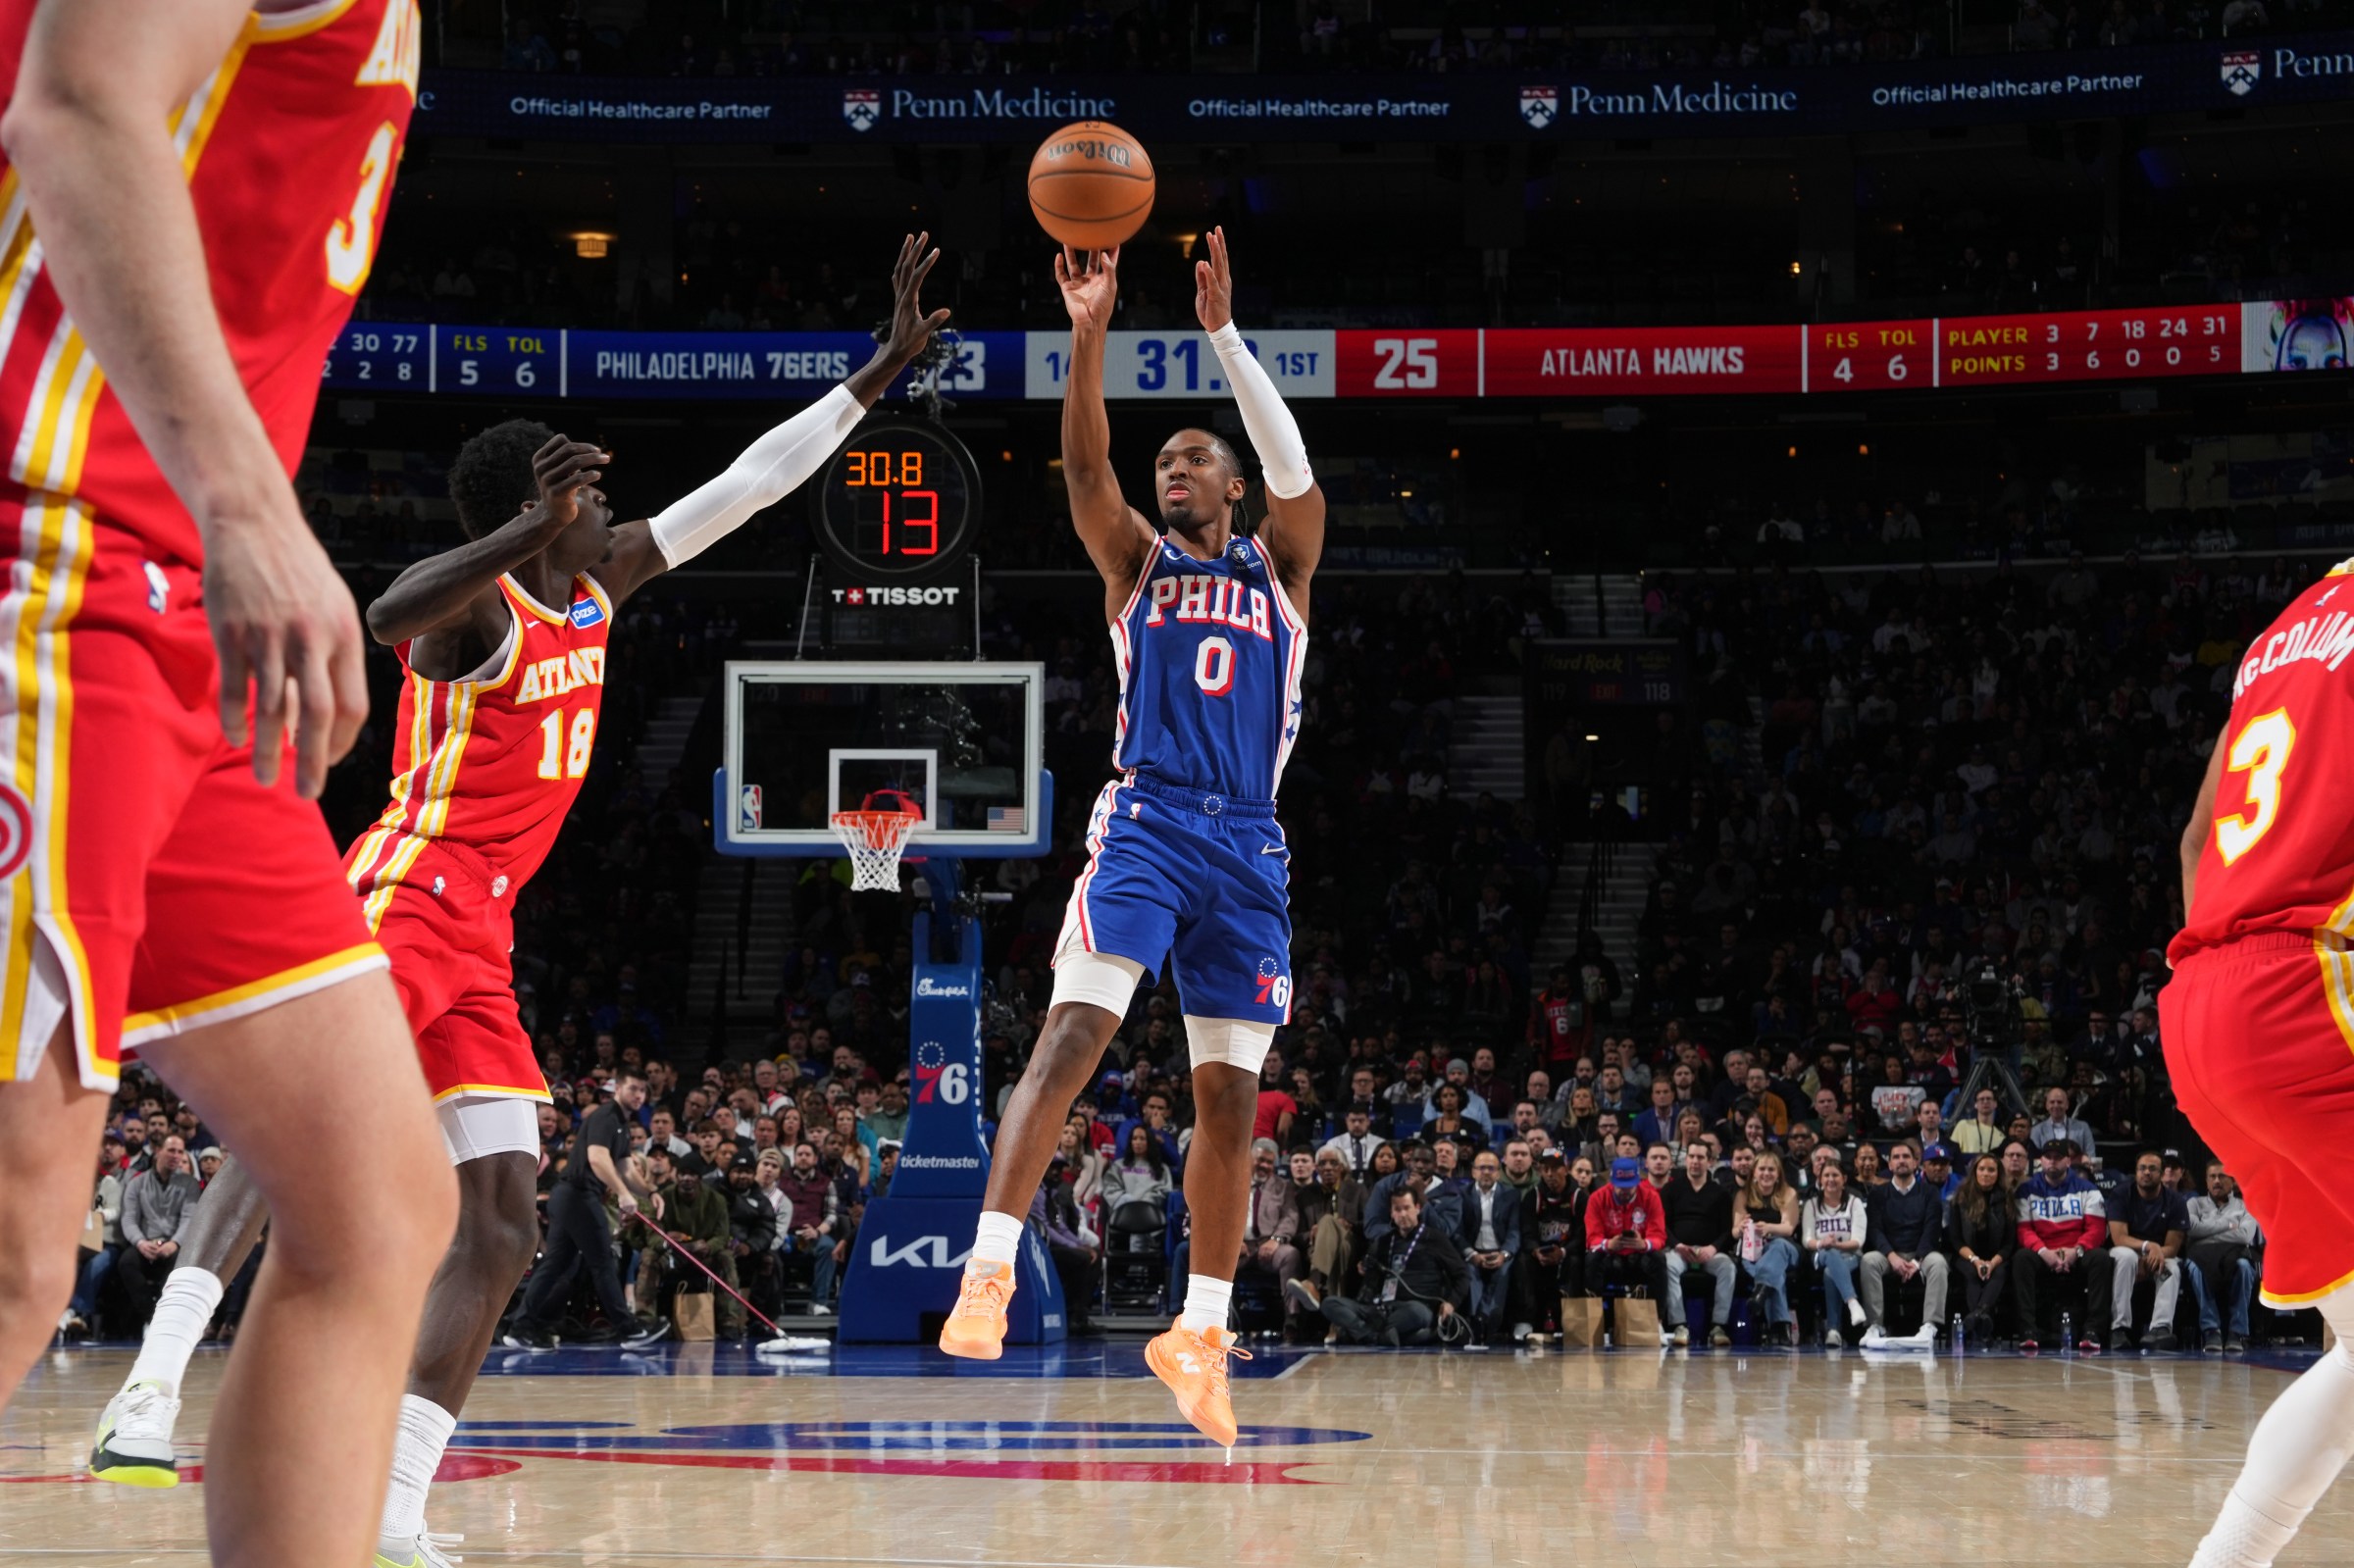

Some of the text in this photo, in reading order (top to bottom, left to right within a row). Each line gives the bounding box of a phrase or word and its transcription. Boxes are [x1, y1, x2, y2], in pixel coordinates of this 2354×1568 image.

[2274, 48, 2354, 78] Penn
[893, 88, 1115, 118] Penn Medicine
[1569, 81, 1797, 115] Penn Medicine
[1871, 74, 2143, 106] Official Healthcare Partner
[510, 96, 771, 119] Official Healthcare Partner
[1188, 98, 1450, 118] Official Healthcare Partner
[1049, 140, 1131, 168] Wilson
[351, 333, 381, 352] 30
[392, 334, 418, 353] 77
[453, 334, 544, 354] FLS TOL
[1826, 329, 1917, 349] FLS TOL
[1948, 316, 2226, 346] PLAYER 3 7 18 24 31
[357, 360, 372, 380] 2
[397, 362, 412, 380] 8
[460, 360, 536, 387] 5 6
[596, 351, 849, 380] PHILADELPHIA 76ERS
[1275, 352, 1319, 377] 1ST
[1374, 338, 1438, 389] 25
[1541, 346, 1744, 377] ATLANTA HAWKS
[1833, 354, 1908, 382] 4 6
[1951, 344, 2221, 375] POINTS 3 6 0 0 5
[845, 451, 923, 486] 30.8
[883, 490, 939, 555] 13
[865, 586, 960, 606] TISSOT
[1147, 575, 1273, 642] PHILA
[1195, 635, 1236, 696] 0
[1643, 682, 1671, 701] 118
[537, 708, 595, 781] 18
[2215, 706, 2296, 868] 3
[1254, 972, 1289, 1008] 76
[916, 1062, 968, 1104] 76
[2029, 1198, 2082, 1218] PHILA
